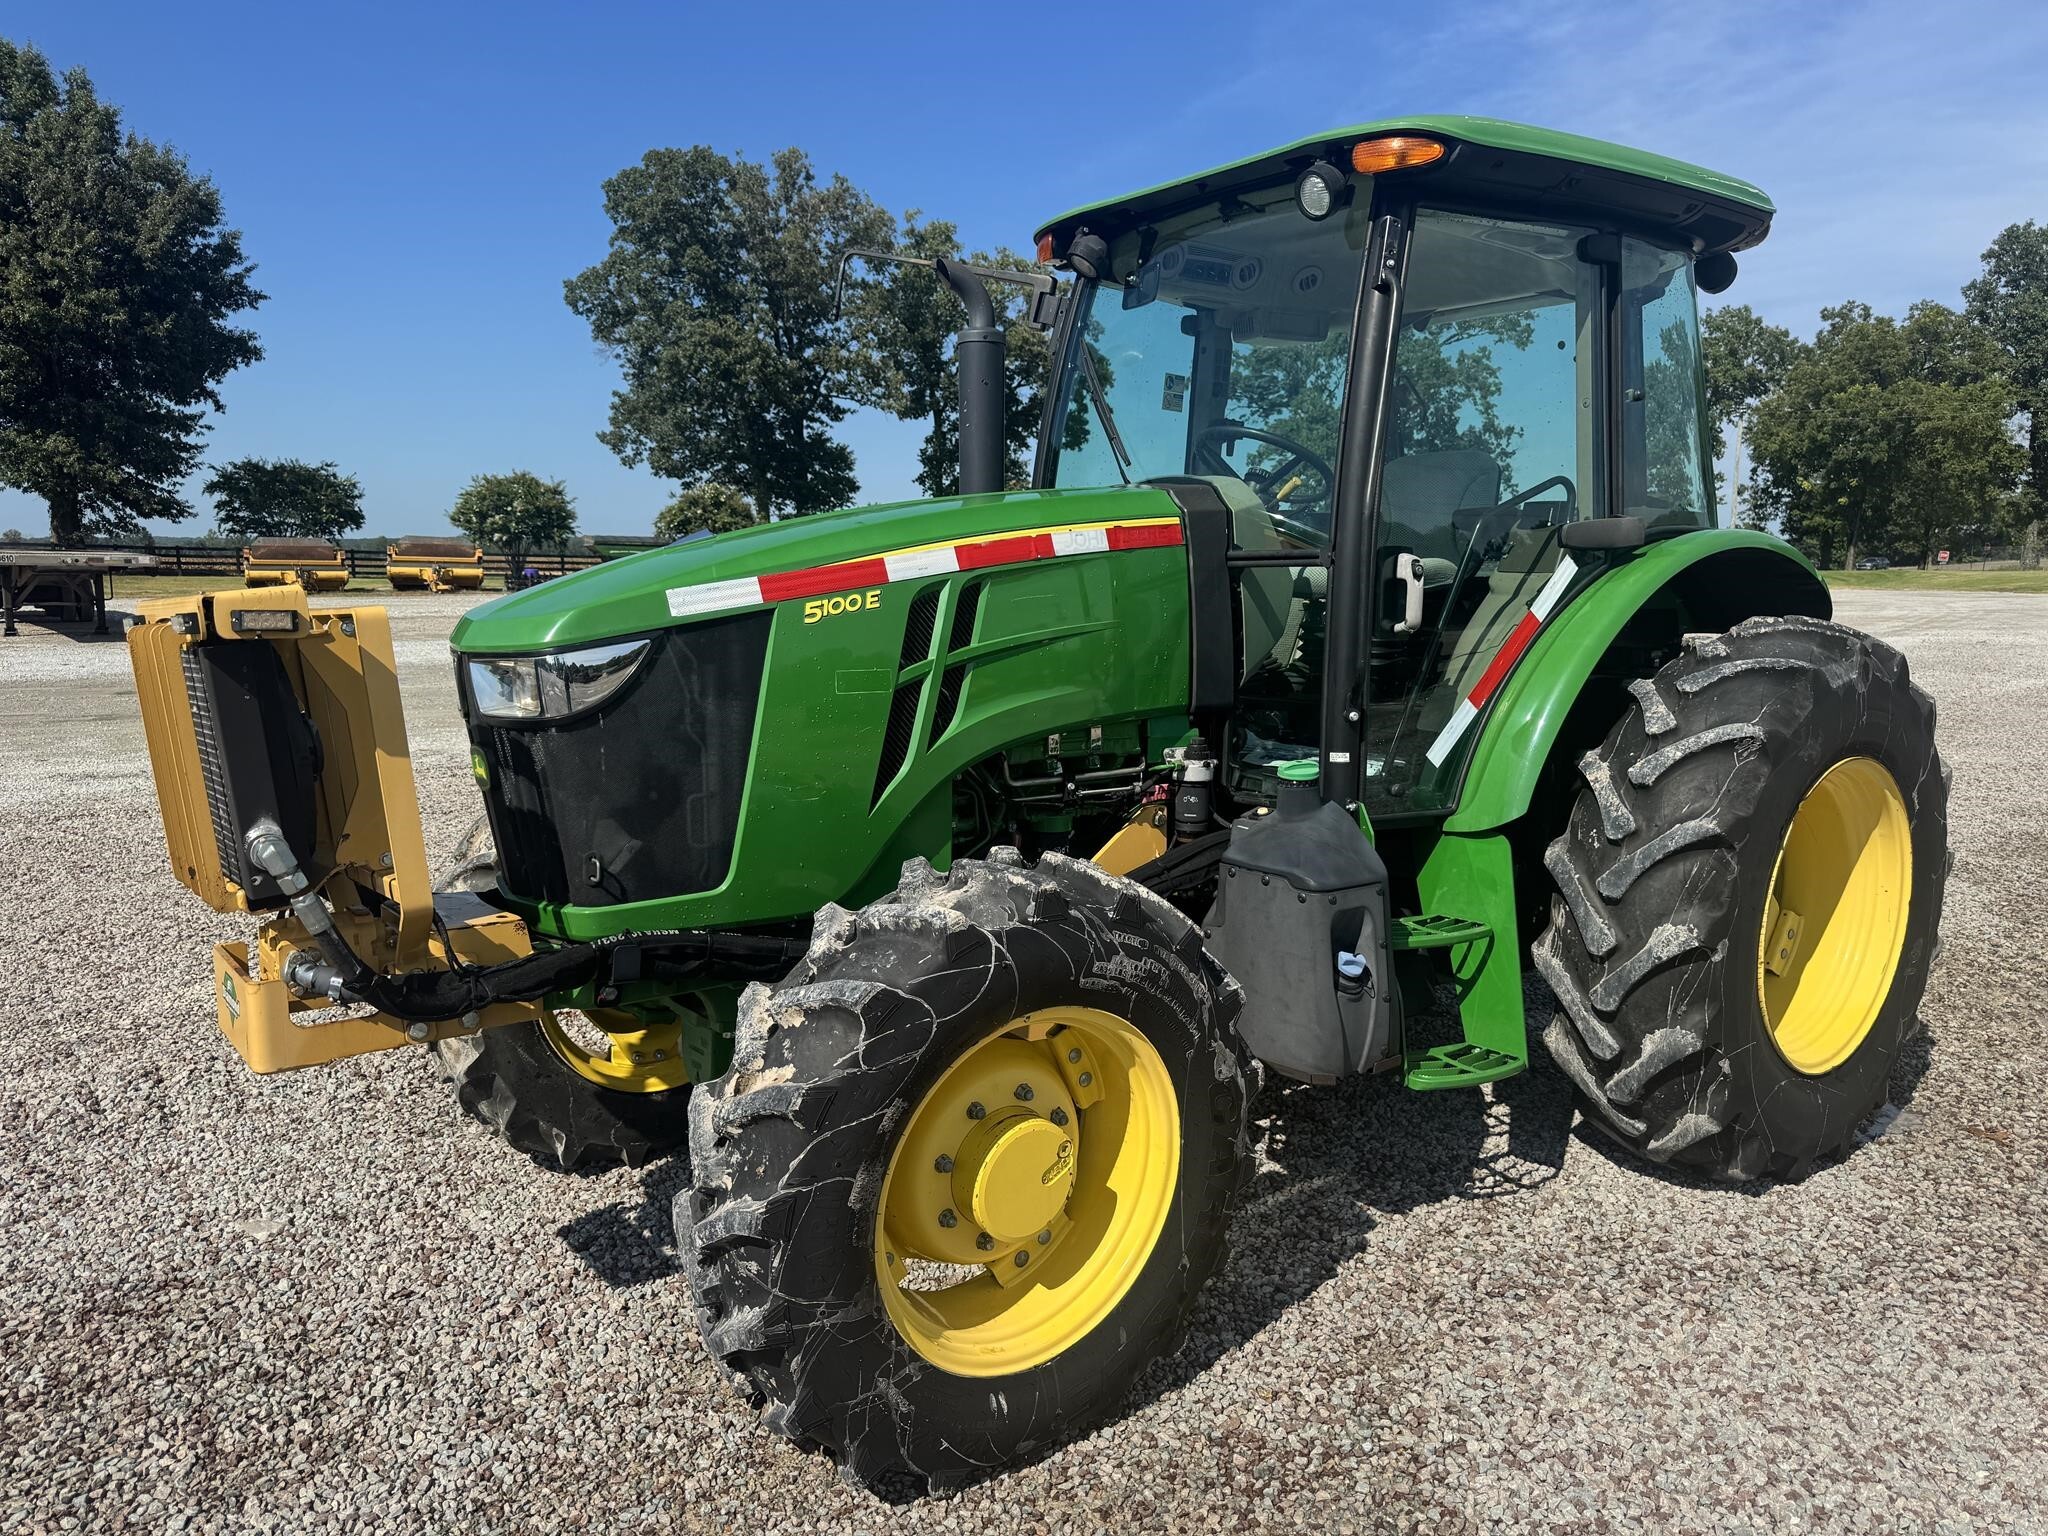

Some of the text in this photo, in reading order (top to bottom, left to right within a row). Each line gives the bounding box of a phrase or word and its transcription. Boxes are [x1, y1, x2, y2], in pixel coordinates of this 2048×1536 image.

[0, 554, 14, 563] 610
[804, 589, 882, 624] 5100 E
